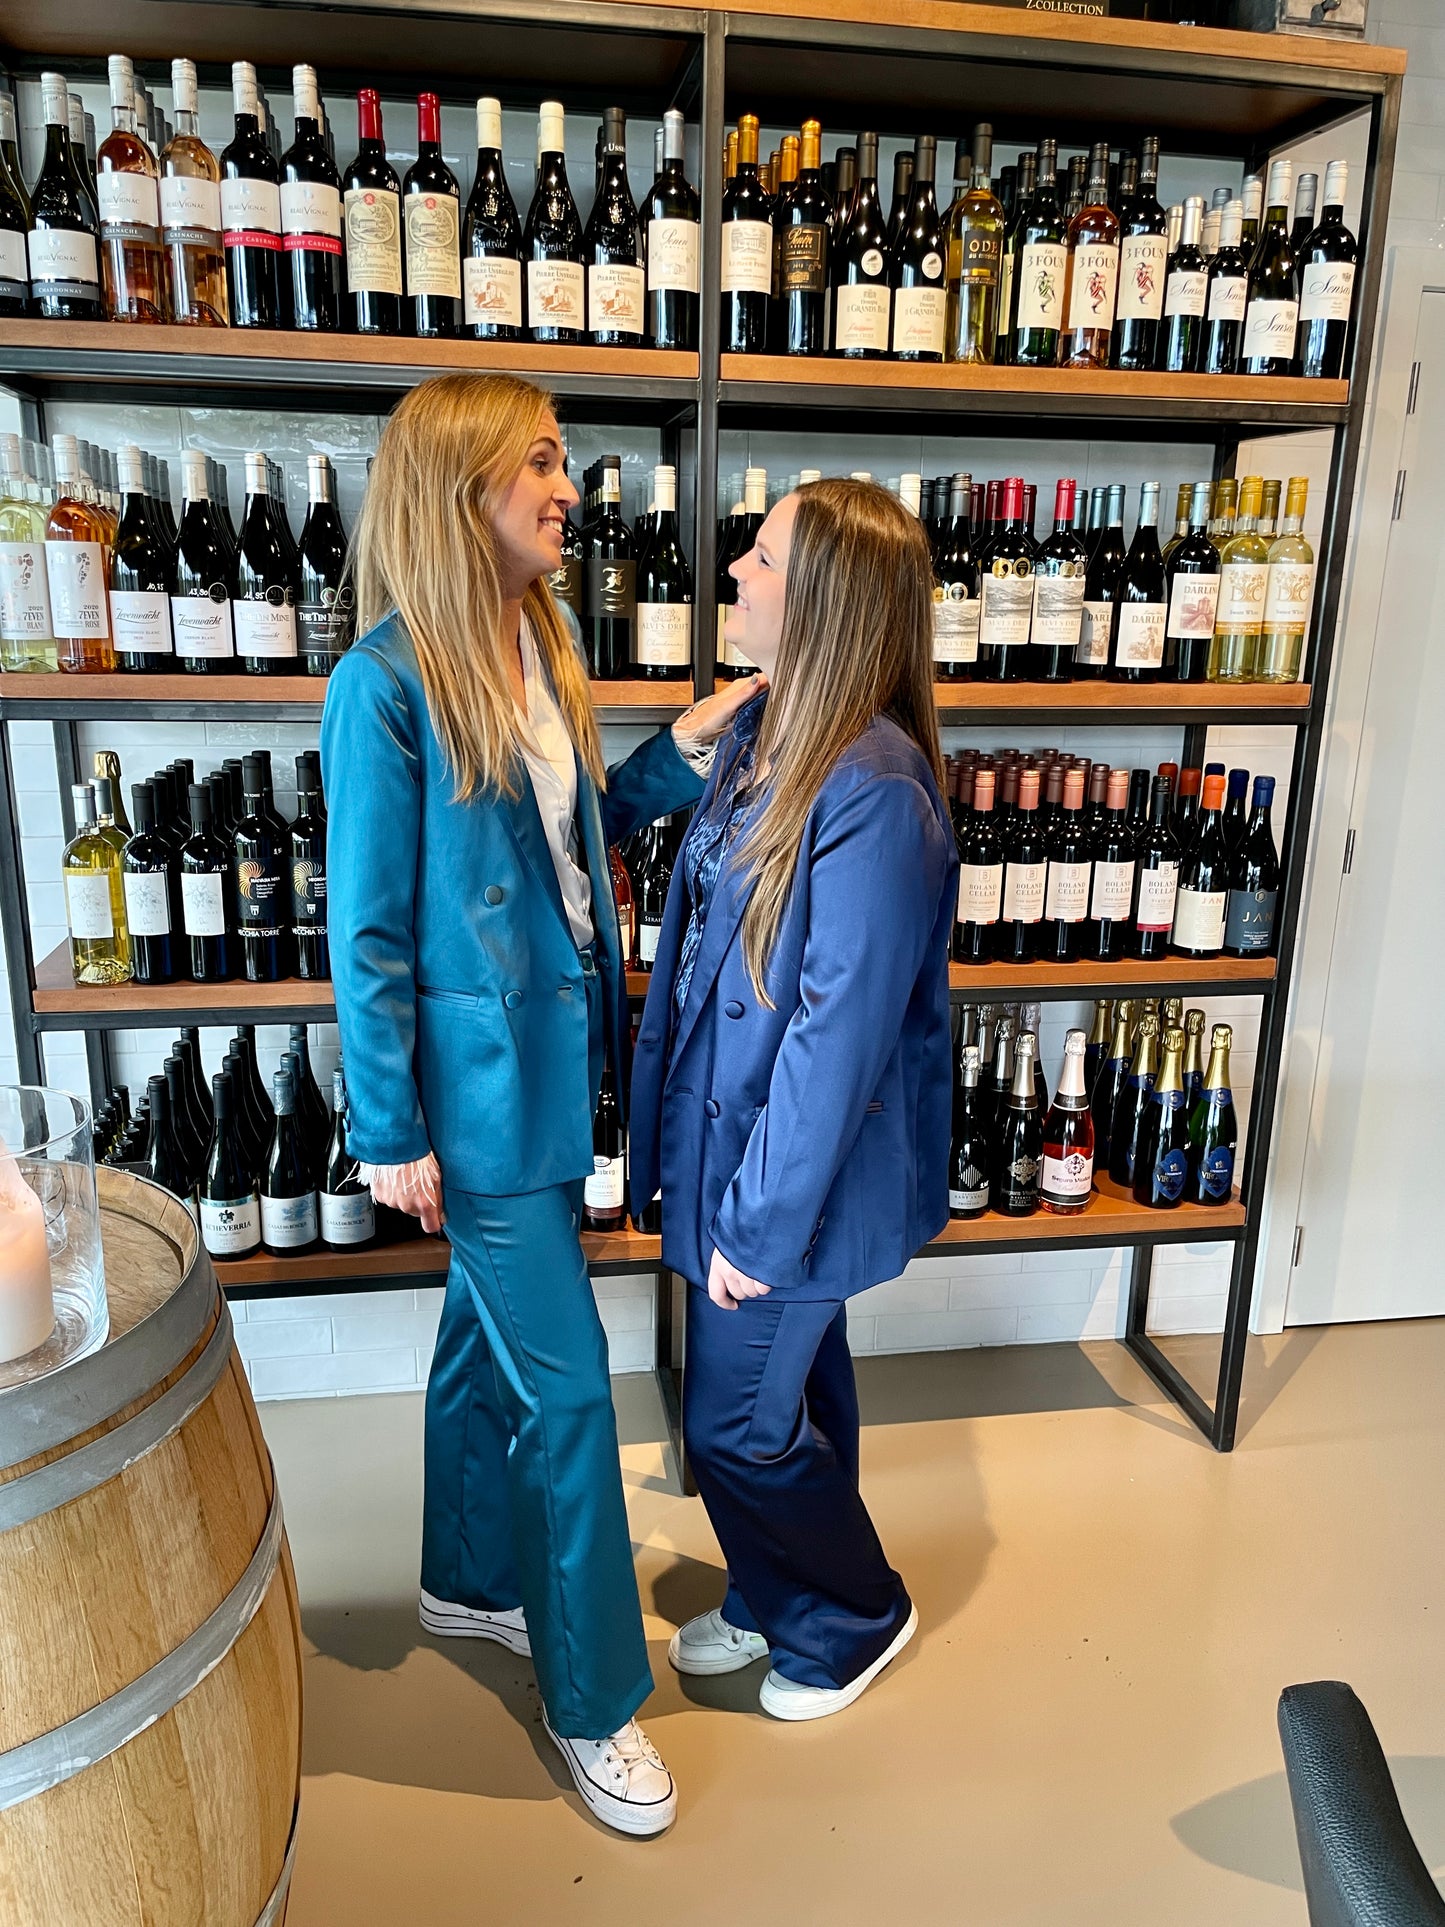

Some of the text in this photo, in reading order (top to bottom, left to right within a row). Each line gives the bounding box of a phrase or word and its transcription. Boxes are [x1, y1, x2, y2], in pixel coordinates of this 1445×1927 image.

[1026, 0, 1104, 16] Z-COLLECTION
[170, 232, 203, 240] GRENACHE
[245, 236, 278, 246] CABERNET
[308, 240, 339, 251] CABERNET
[969, 239, 998, 254] ODE
[1127, 248, 1164, 261] 3 FOUS
[1027, 256, 1064, 269] 3 FOUS
[1080, 257, 1116, 270] 3 FOUS
[79, 611, 100, 620] 7EVEN
[271, 613, 290, 622] MINE
[299, 612, 312, 621] THE
[312, 612, 326, 622] TIN
[1242, 911, 1273, 922] JAN
[238, 929, 280, 938] VECCHIA TORRE
[292, 928, 316, 936] VECCHIA
[206, 1220, 252, 1232] ECHEVERRIA
